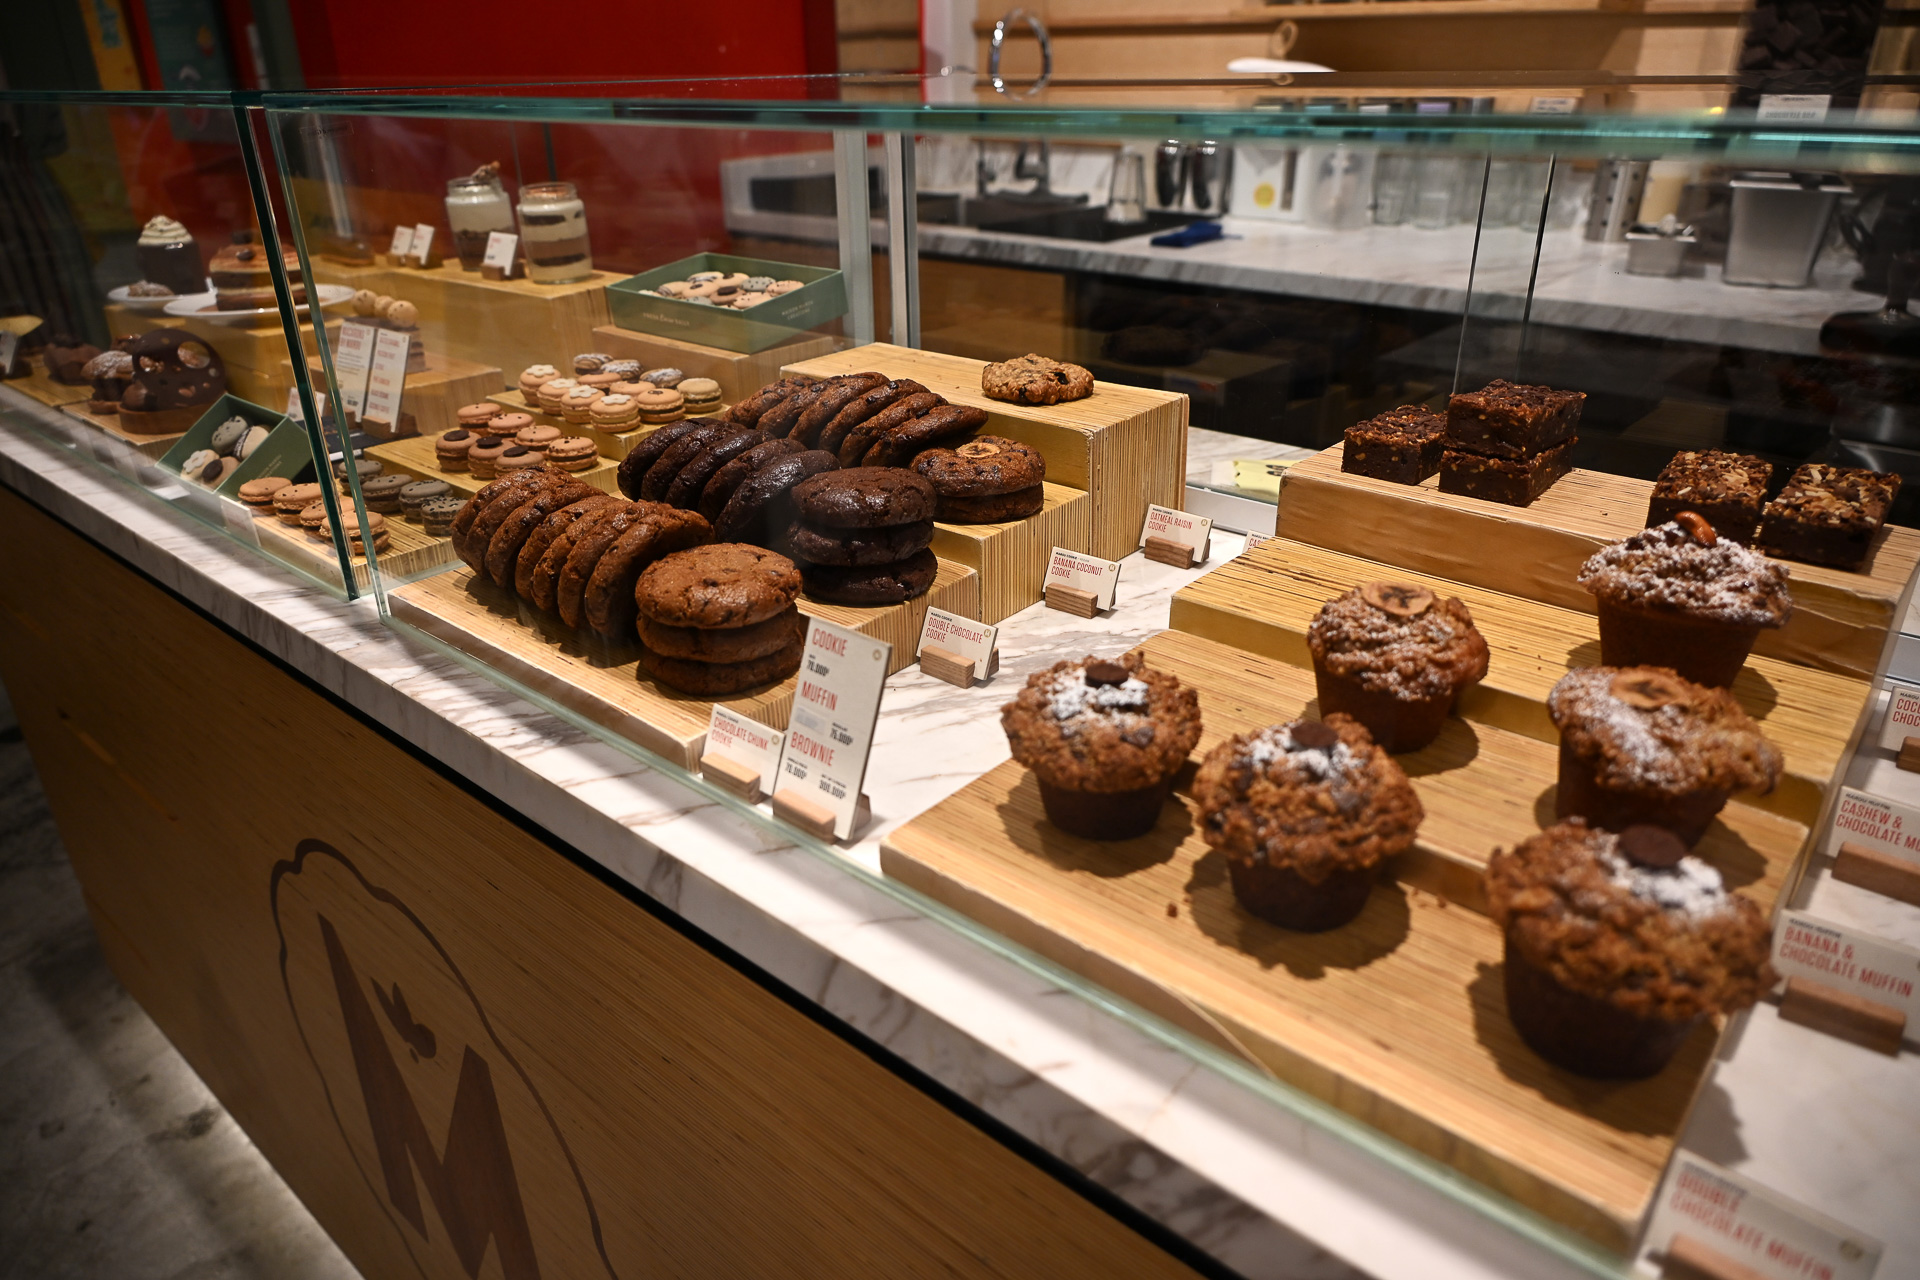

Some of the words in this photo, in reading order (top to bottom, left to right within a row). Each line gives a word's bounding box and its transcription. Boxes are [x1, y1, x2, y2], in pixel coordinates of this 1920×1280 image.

[1148, 521, 1167, 533] COOKIE
[1150, 511, 1174, 525] OATMEAL
[1174, 517, 1193, 530] RAISIN
[1050, 566, 1071, 579] COOKIE
[1053, 556, 1076, 570] BANANA
[1076, 562, 1103, 576] COCONUT
[812, 627, 848, 657] COOKIE
[925, 627, 947, 643] COOKIE
[928, 616, 950, 633] DOUBLE
[950, 624, 983, 644] CHOCOLATE
[801, 681, 838, 711] MUFFIN
[711, 729, 733, 749] COOKIE
[713, 716, 747, 741] CHOCOLATE
[747, 731, 769, 751] CHUNK
[790, 731, 835, 767] BROWNIE
[1836, 813, 1903, 846] CHOCOLATE
[1841, 799, 1892, 825] CASHEW
[1892, 815, 1902, 830] &
[1784, 926, 1840, 955] BANANA
[1842, 943, 1855, 960] &
[1779, 942, 1858, 980] CHOCOLATE
[1858, 967, 1915, 998] MUFFIN
[1669, 1188, 1764, 1253] CHOCOLATE
[1765, 1240, 1836, 1280] MUFFIN
